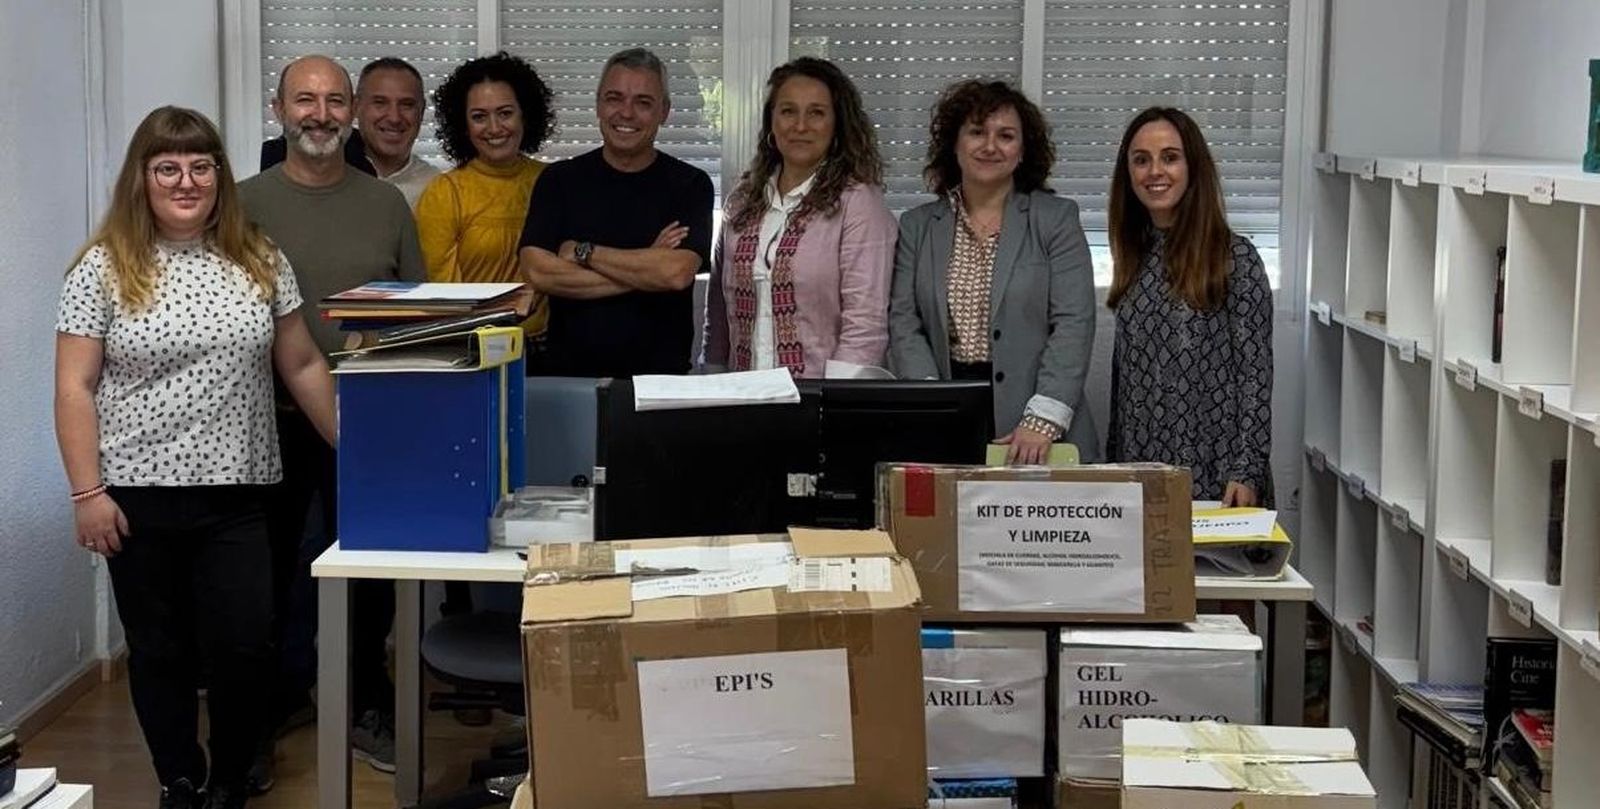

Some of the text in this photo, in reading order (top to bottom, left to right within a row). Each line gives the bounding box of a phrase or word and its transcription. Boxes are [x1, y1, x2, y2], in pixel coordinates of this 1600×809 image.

[976, 503, 1123, 519] KIT DE PROTECCIÓN
[1008, 529, 1092, 543] Y LIMPIEZA
[1077, 666, 1123, 682] GEL
[714, 672, 774, 693] EPI'S
[924, 690, 1015, 707] ARILLAS
[1078, 690, 1159, 706] HIDRO-
